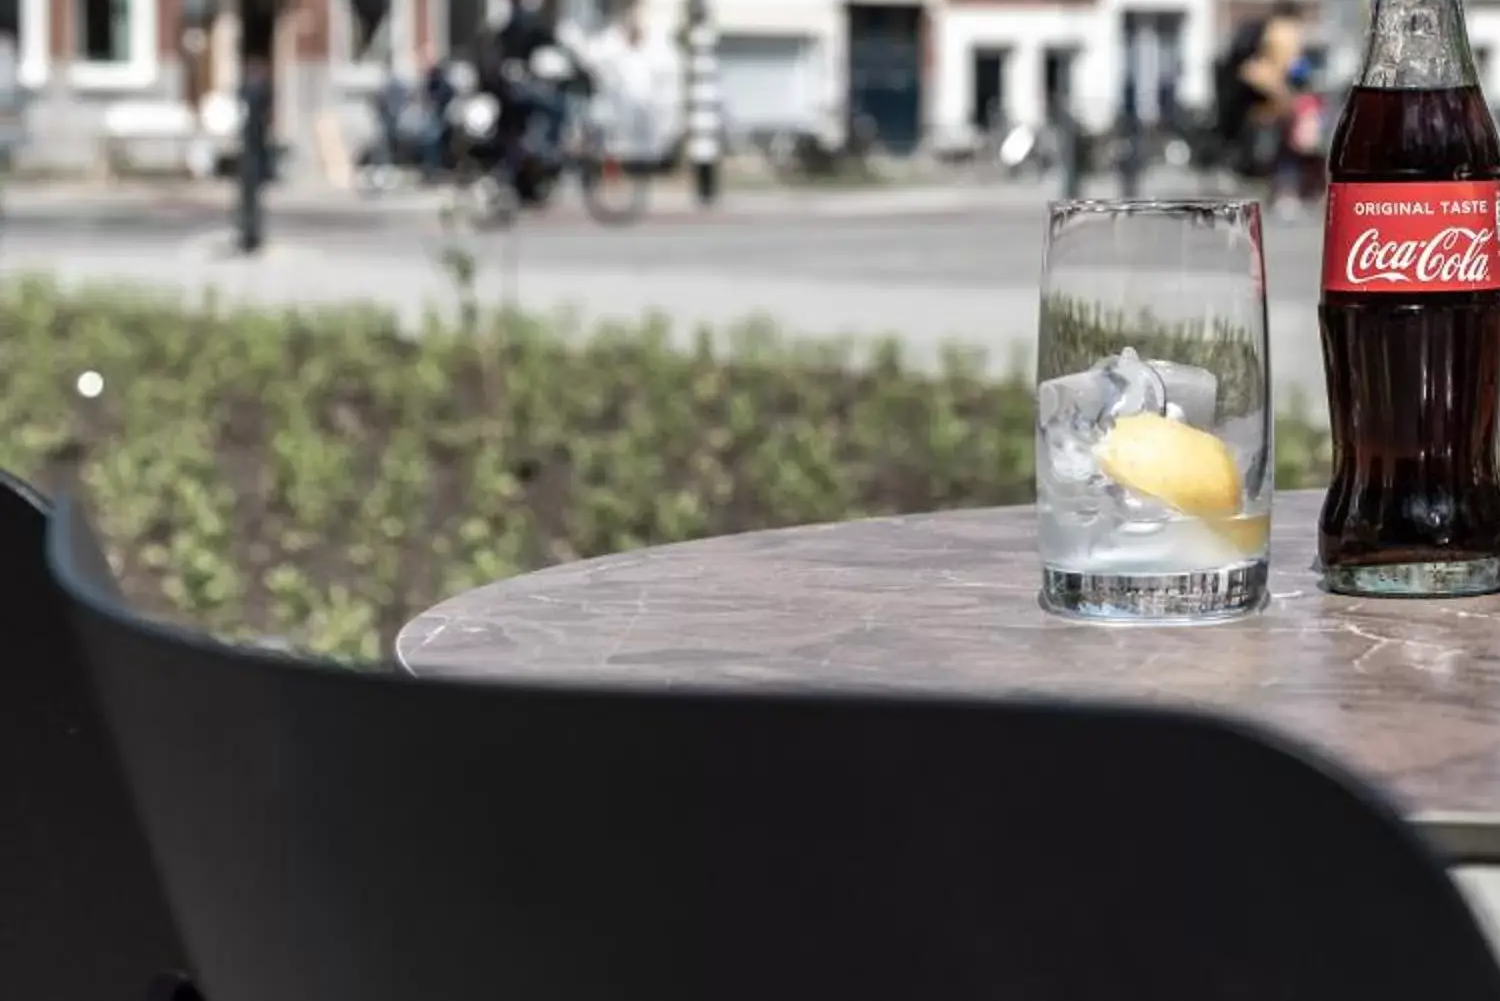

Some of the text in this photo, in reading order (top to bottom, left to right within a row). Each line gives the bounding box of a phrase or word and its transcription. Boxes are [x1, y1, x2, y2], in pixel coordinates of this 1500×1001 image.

[1355, 200, 1488, 216] ORIGINAL TASTE
[1346, 227, 1494, 284] Coca-Cola
